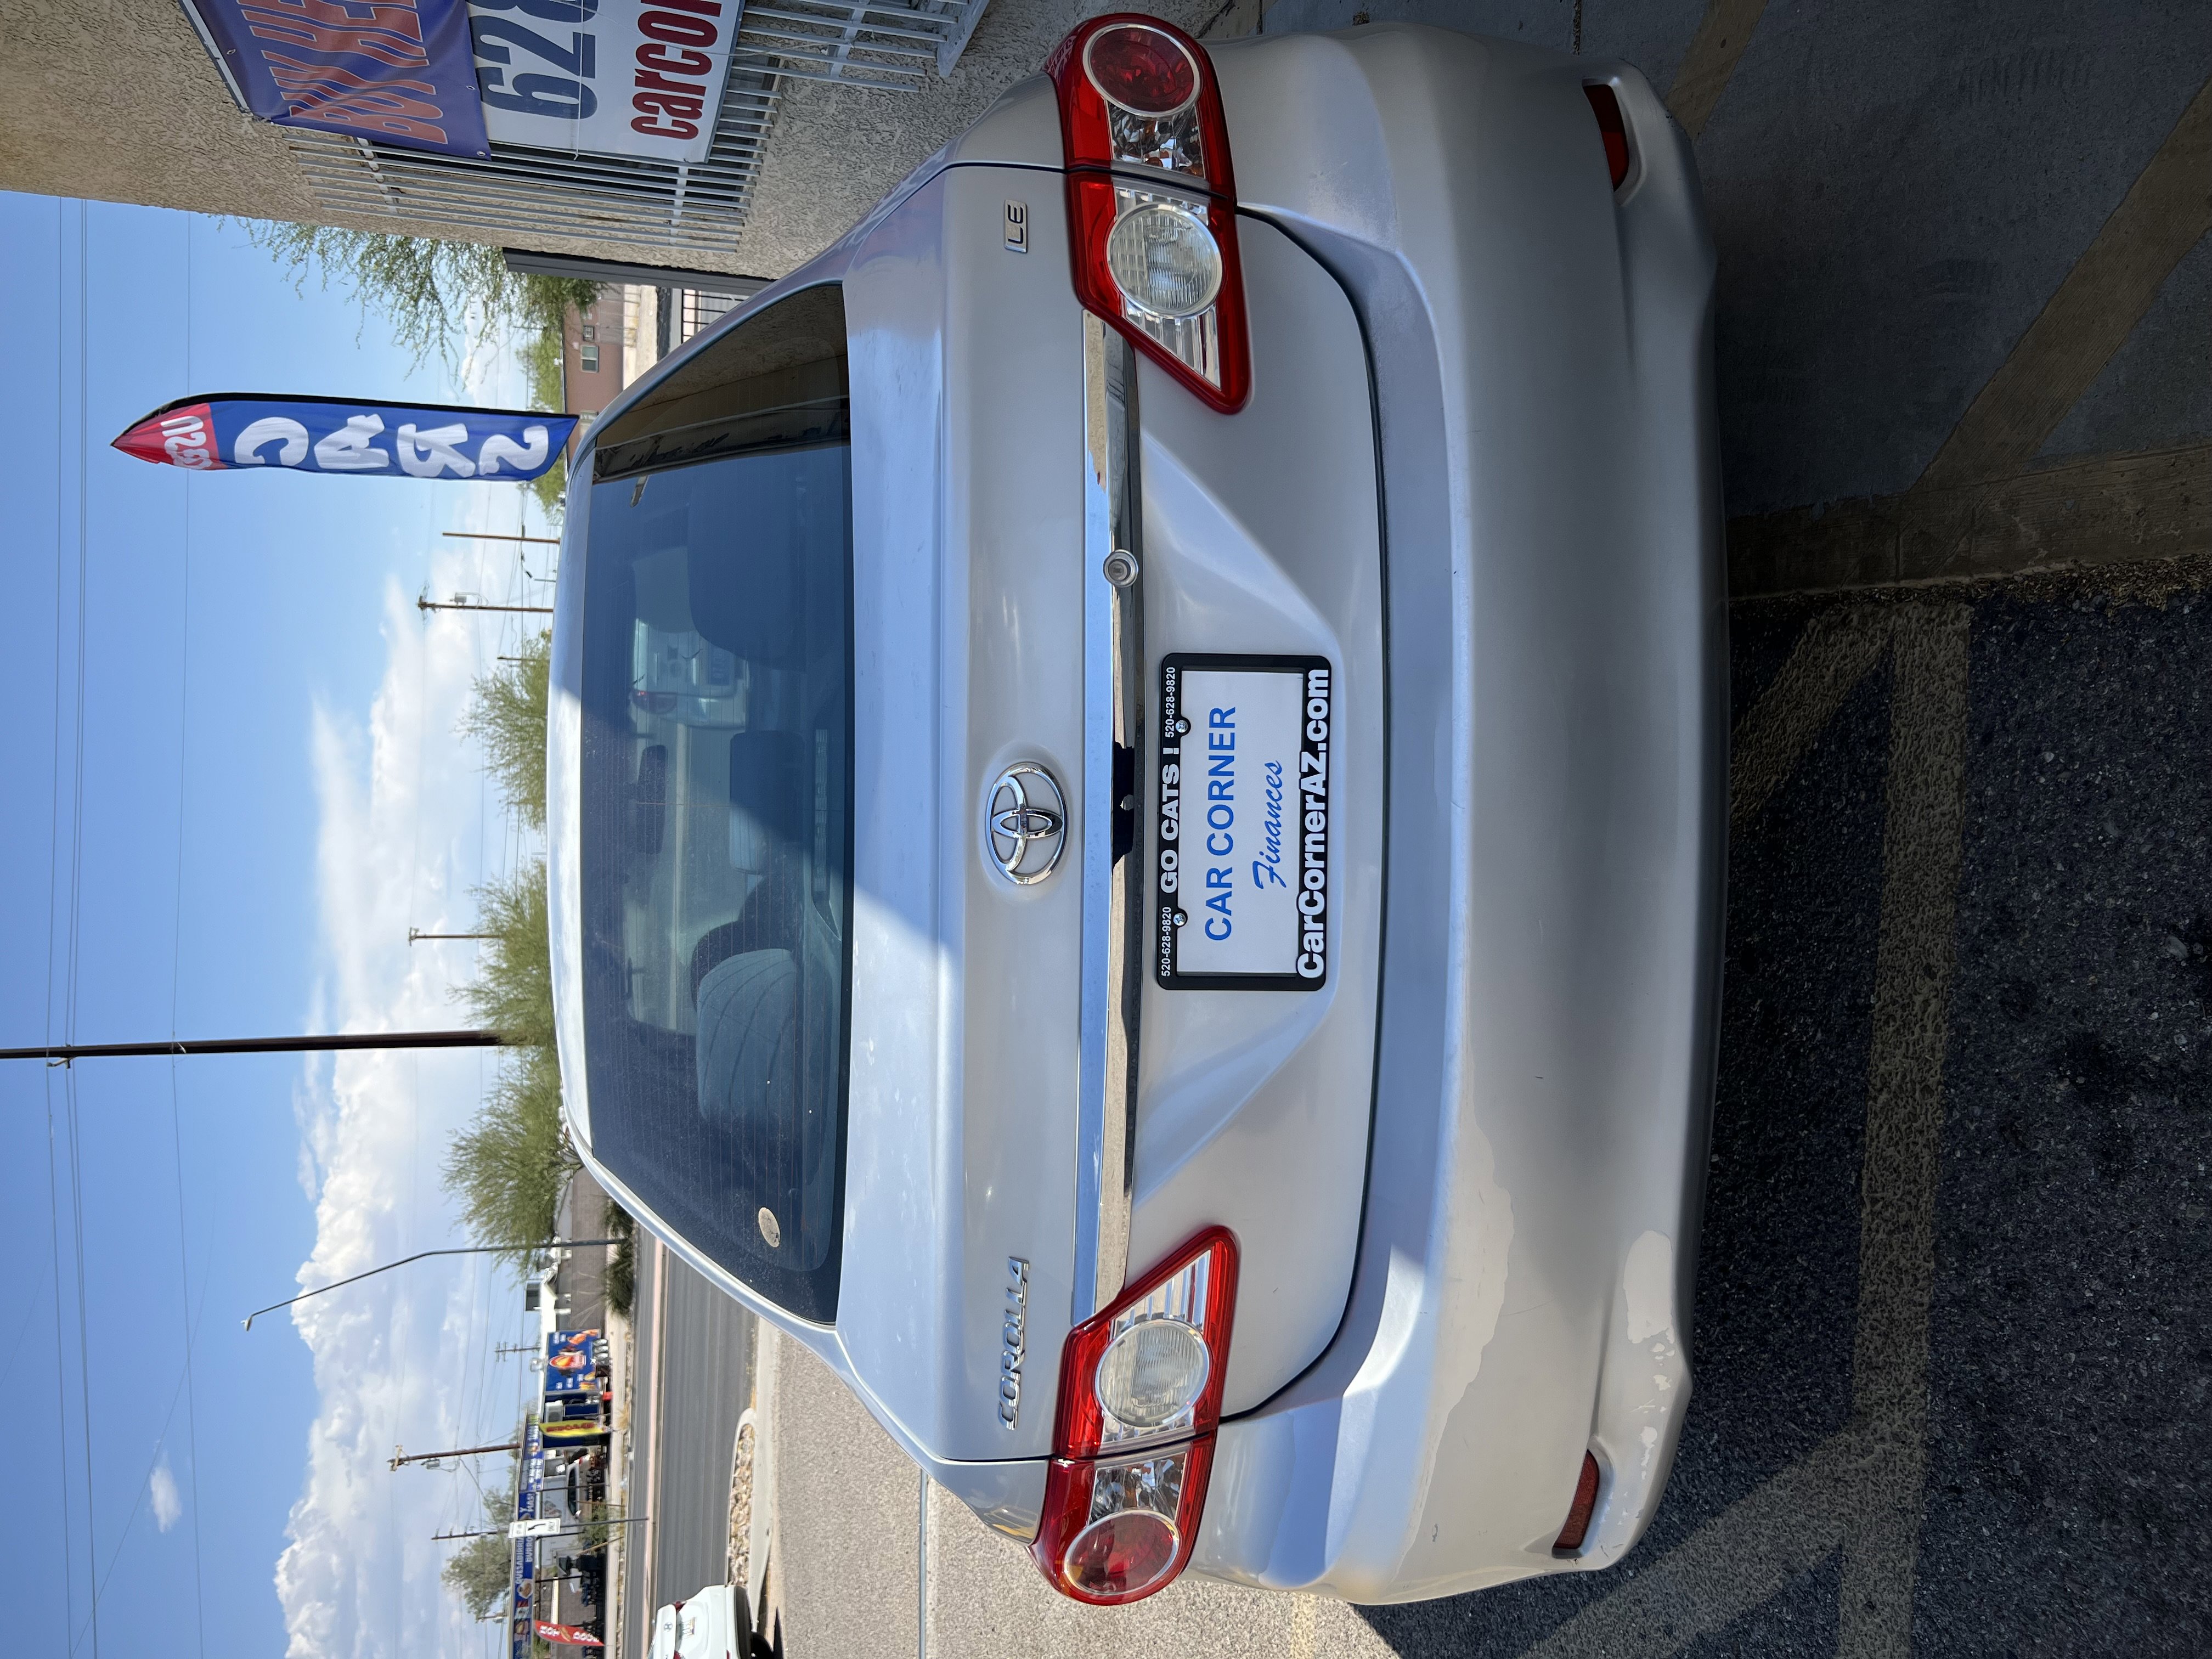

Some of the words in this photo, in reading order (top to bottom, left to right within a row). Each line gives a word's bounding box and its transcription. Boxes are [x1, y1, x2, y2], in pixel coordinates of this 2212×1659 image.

[236, 0, 430, 67] HE
[261, 50, 448, 144] BUY
[1007, 204, 1024, 244] LE
[1165, 667, 1176, 738] 520-628-9820
[1161, 764, 1180, 841] CATS
[1206, 707, 1236, 856] CORNER
[1252, 759, 1286, 889] Finances
[1297, 669, 1329, 978] CarCornerAZ.com
[1161, 849, 1179, 894] GO
[1204, 867, 1233, 941] CAR
[1161, 906, 1172, 977] 520-628-9820
[997, 1256, 1029, 1430] COROLLA
[539, 1625, 560, 1637] HOT
[572, 1631, 600, 1643] DOGS
